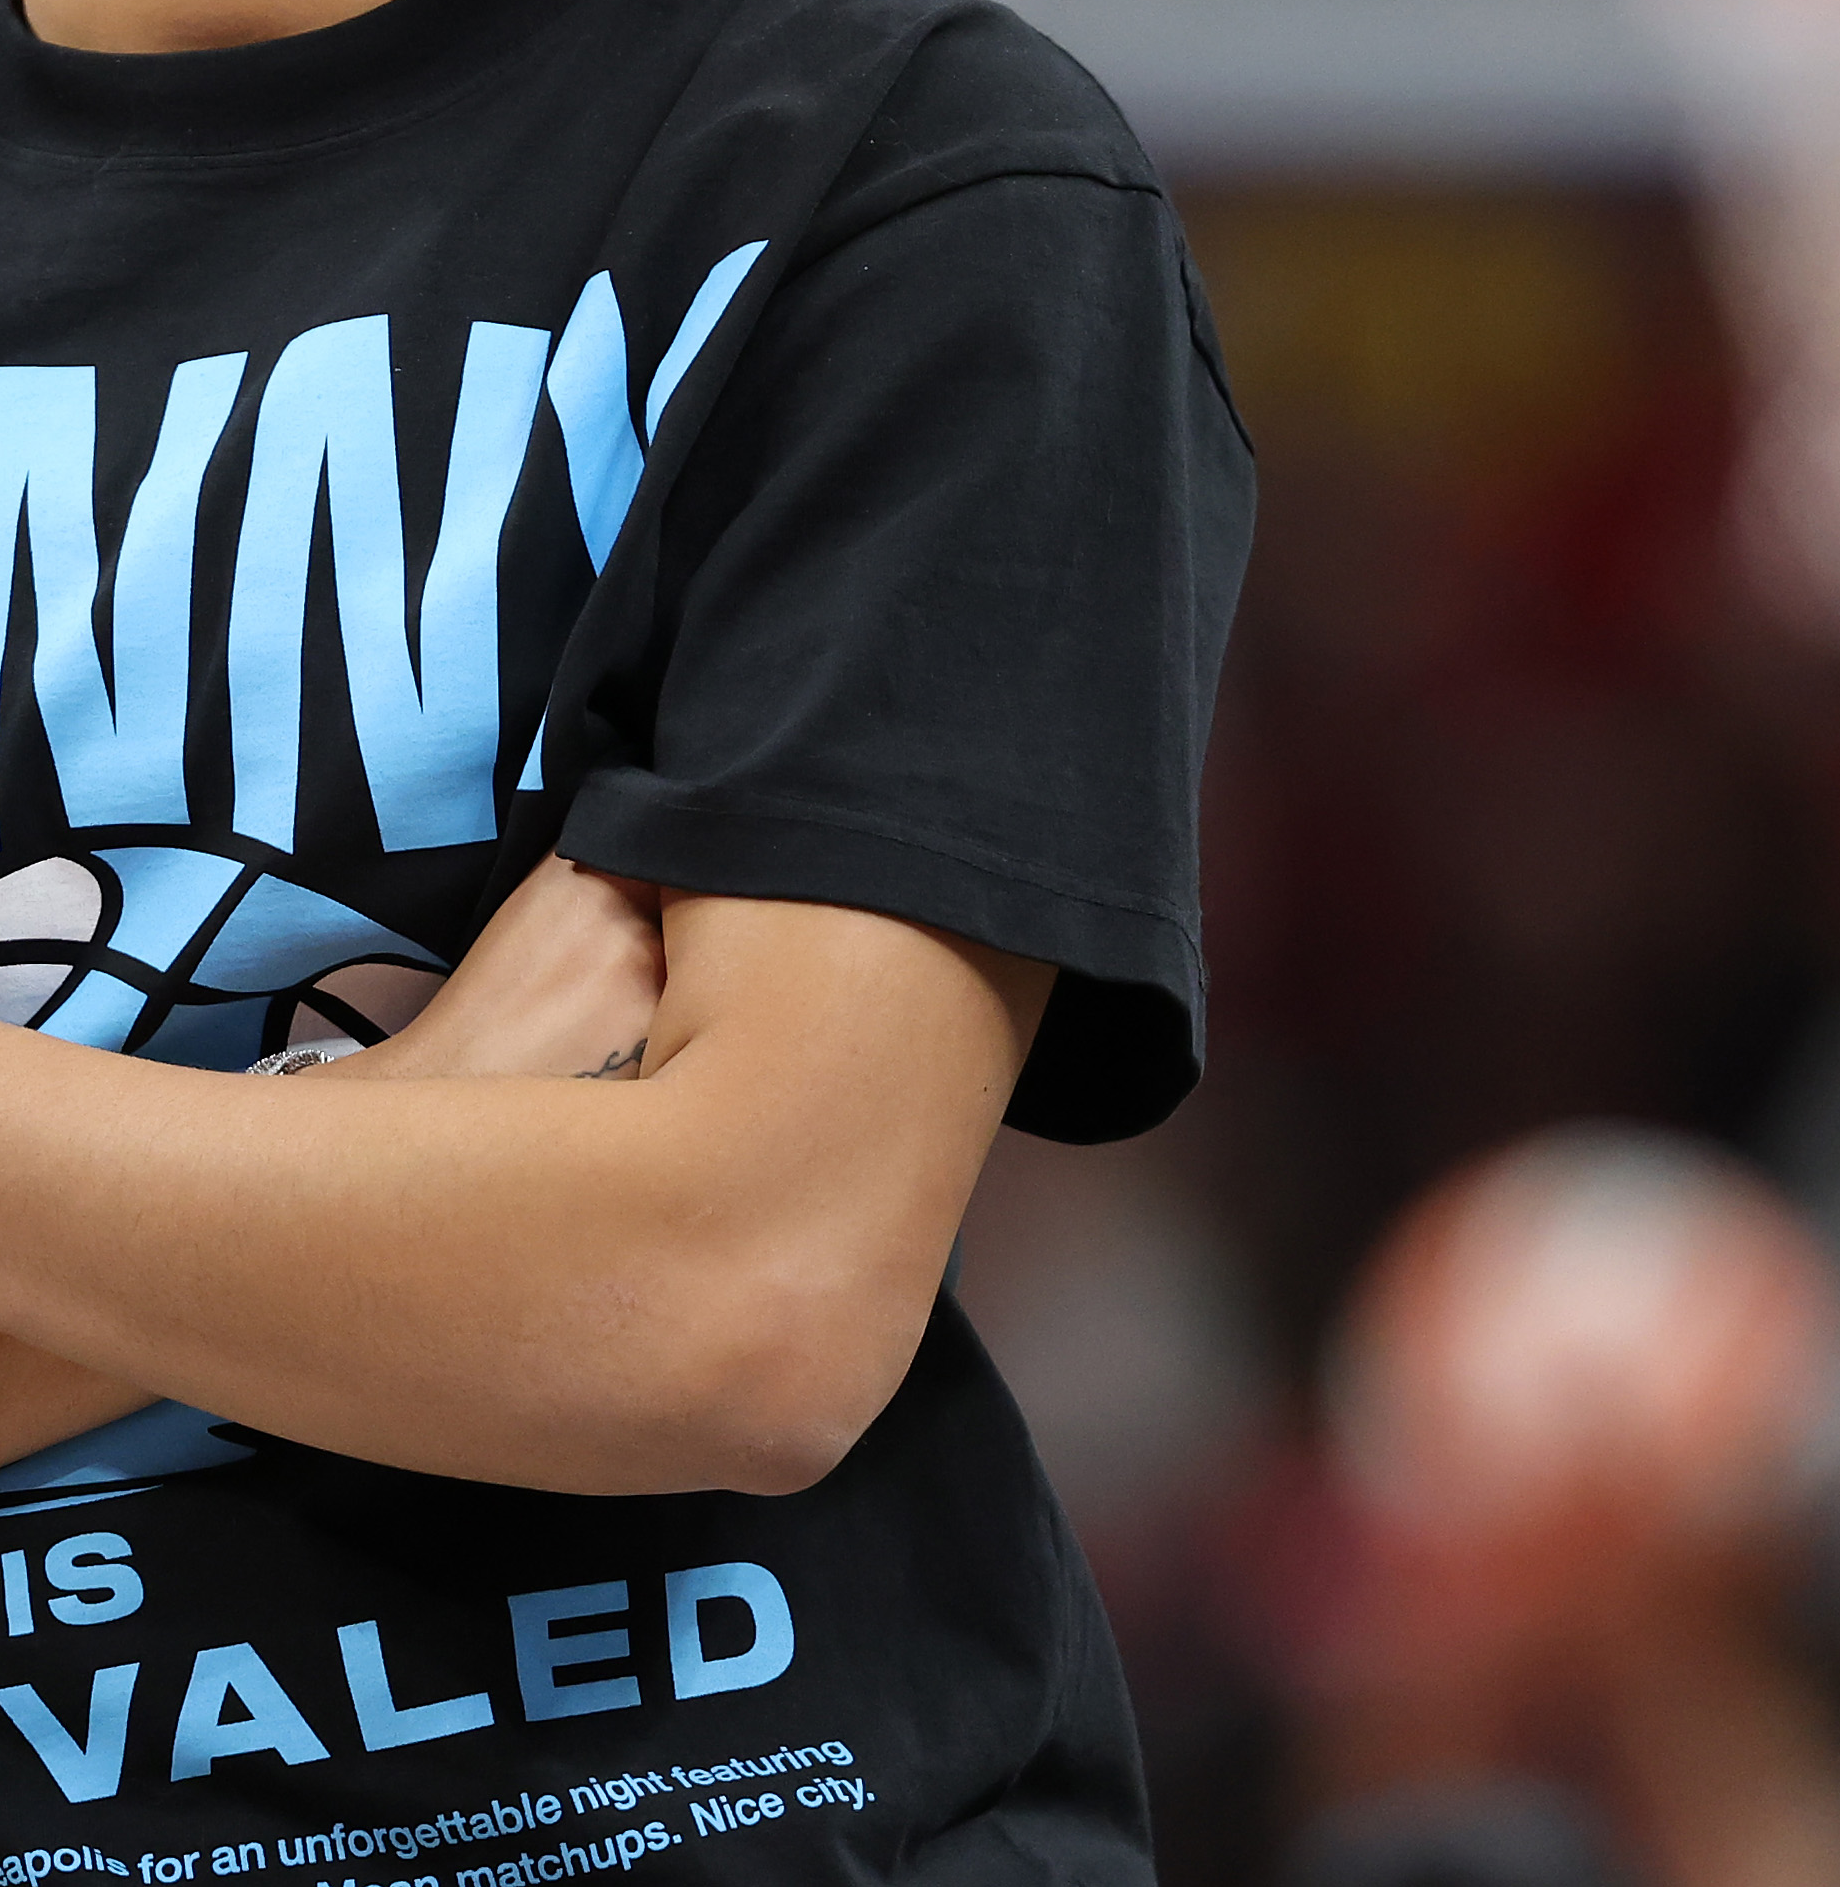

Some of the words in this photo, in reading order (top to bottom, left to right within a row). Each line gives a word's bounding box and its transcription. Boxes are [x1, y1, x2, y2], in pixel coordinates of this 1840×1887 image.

[1, 1532, 145, 1637] IS
[137, 1852, 201, 1884] for
[211, 1842, 267, 1876] an
[278, 1793, 563, 1867] unforgettable
[569, 1771, 674, 1815] night
[671, 1740, 854, 1788] featuring
[456, 1822, 683, 1887] matchups.
[689, 1793, 786, 1837] Nice
[796, 1777, 876, 1811] city.
